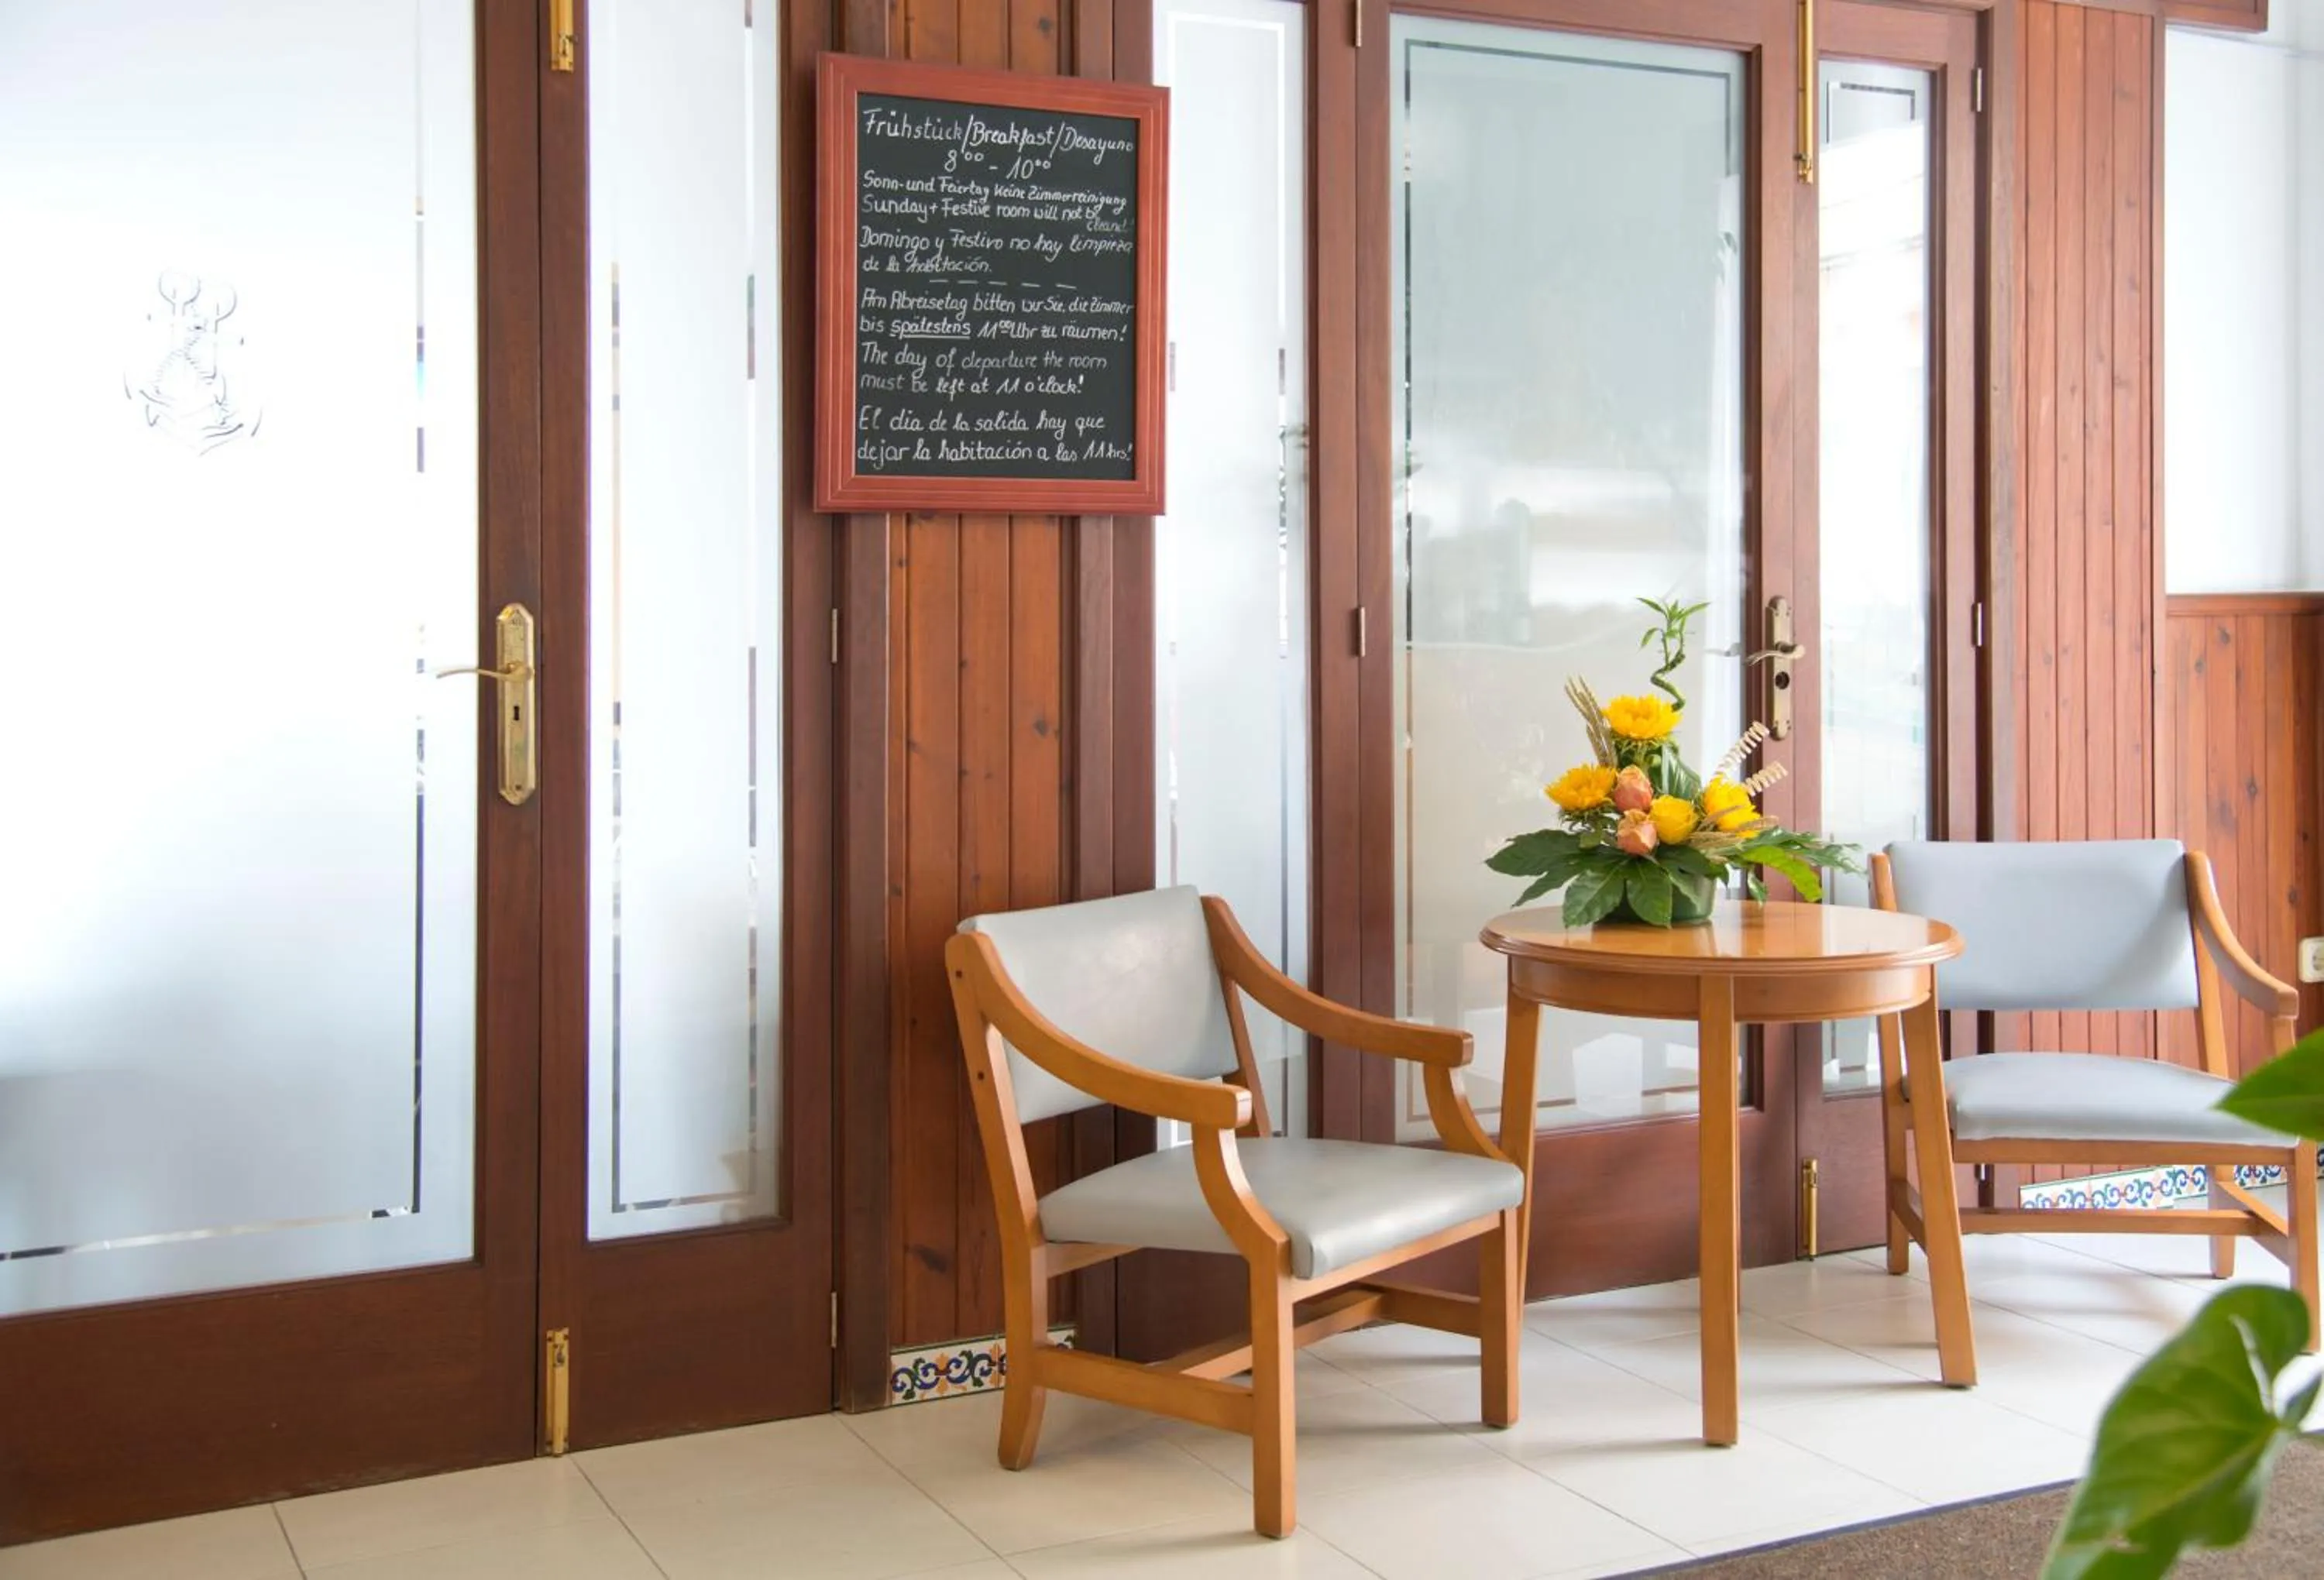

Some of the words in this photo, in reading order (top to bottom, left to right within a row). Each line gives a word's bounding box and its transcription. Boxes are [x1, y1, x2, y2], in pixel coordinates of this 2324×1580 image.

[861, 194, 928, 224] Sunday
[996, 204, 1030, 218] room
[1033, 204, 1059, 221] will
[1061, 205, 1083, 221] not
[859, 225, 930, 263] Domingo
[1009, 237, 1031, 251] no
[1033, 233, 1063, 263] hay
[862, 254, 880, 272] de
[885, 254, 900, 273] la
[861, 287, 887, 309] Am
[972, 292, 1016, 313] bitten
[1022, 298, 1043, 313] wir
[1068, 297, 1089, 312] die
[860, 314, 885, 333] bis
[889, 315, 971, 340] spätestens
[1041, 325, 1057, 338] zu
[861, 342, 889, 364] The
[894, 343, 927, 379] day
[935, 348, 957, 377] of
[961, 350, 1037, 378] departure
[1043, 350, 1064, 368] the
[1068, 356, 1107, 369] room
[861, 373, 906, 390] must
[911, 376, 929, 393] be
[935, 376, 965, 402] left
[971, 377, 989, 394] at
[995, 377, 1020, 395] 11
[858, 405, 882, 430] El
[929, 409, 947, 431] de
[951, 412, 970, 431] la
[974, 410, 1030, 431] salida
[1036, 409, 1067, 441] hay
[1075, 417, 1106, 438] que
[858, 439, 911, 470] dejar
[913, 438, 931, 461] la
[937, 438, 1033, 462] habitación
[1037, 447, 1050, 461] a
[1055, 442, 1078, 462] las
